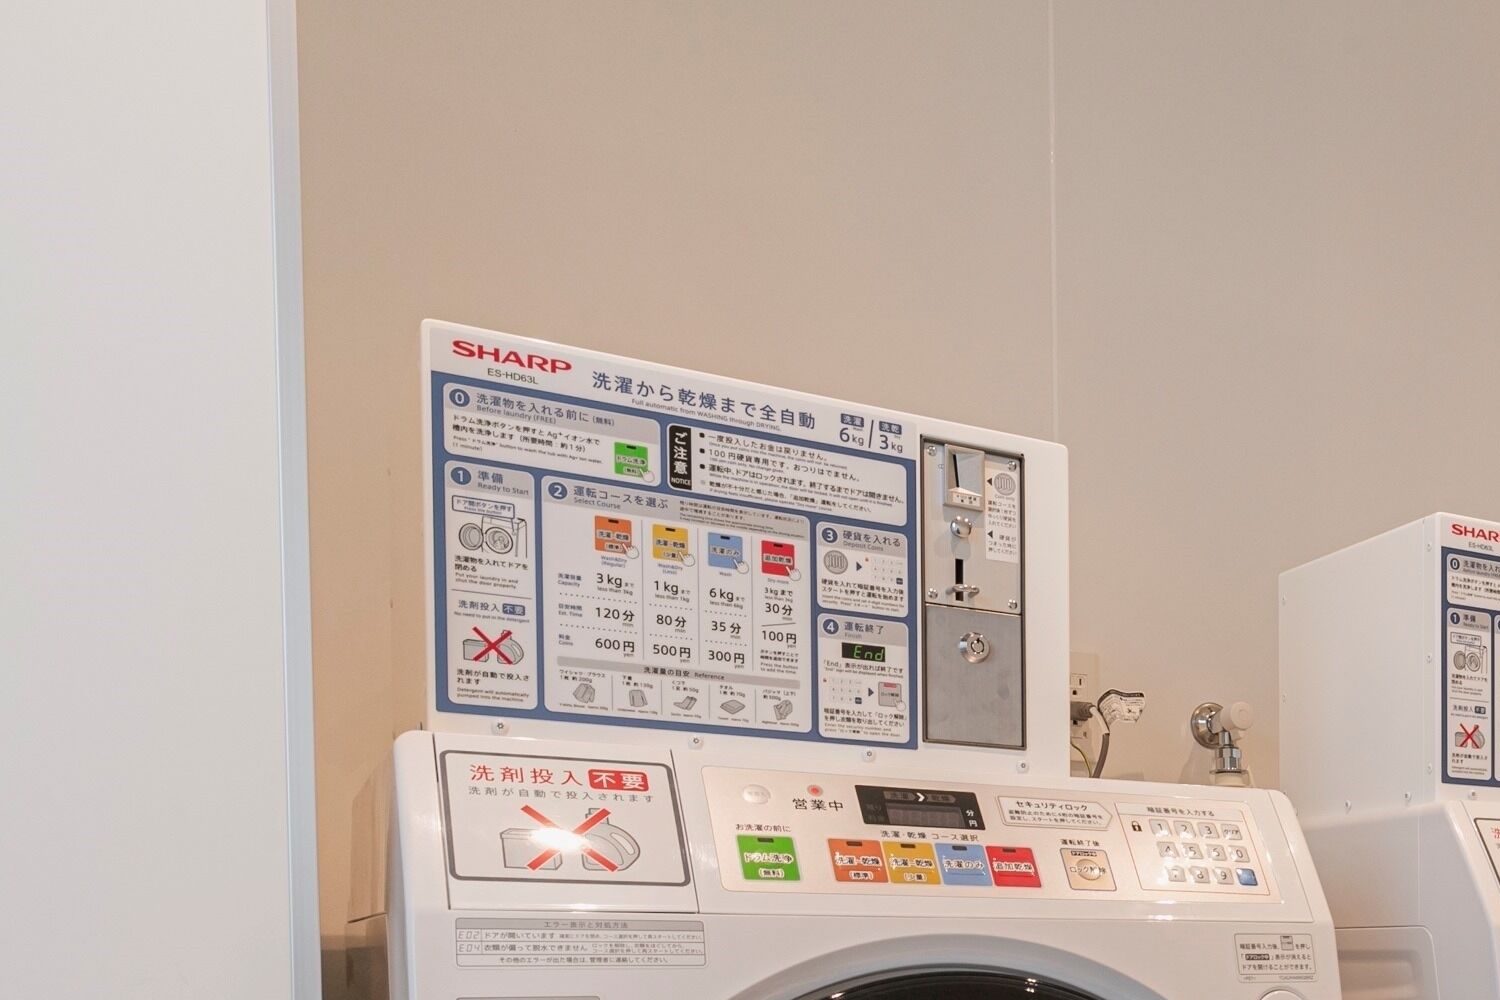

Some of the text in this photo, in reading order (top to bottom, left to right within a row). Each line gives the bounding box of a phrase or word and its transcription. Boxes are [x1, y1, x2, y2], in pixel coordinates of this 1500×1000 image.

[452, 340, 572, 374] SHARP
[487, 367, 538, 385] ES-HD63L
[592, 370, 816, 430] 洗濯から乾燥まで全自動
[476, 392, 589, 423] 洗濯物を入れる前に
[673, 431, 688, 476] ご注意
[477, 470, 504, 485] 準備
[671, 477, 692, 487] NOTICE
[477, 482, 529, 496] Ready to Start
[573, 485, 669, 510] 運転コースを選ぶ
[842, 530, 901, 547] 硬貨を入れる
[458, 599, 500, 613] 洗剤投入
[844, 621, 884, 635] 運転終了
[853, 645, 885, 661] End
[643, 665, 690, 678] 洗濯量の目安
[469, 763, 645, 790] 洗剤投入 不要
[467, 786, 654, 803] 洗剤が自動で投入されます
[792, 798, 844, 812] 営業中
[1016, 800, 1088, 812] セキュリティロック
[1146, 806, 1215, 817] 暗証番号を入力する
[966, 809, 975, 817] 分
[735, 823, 792, 833] お洗濯の前に
[968, 820, 978, 828] 円
[1204, 825, 1213, 835] 3
[931, 833, 979, 842] コース選択
[1060, 838, 1100, 847] 運転終了後
[744, 852, 793, 864] ドラム洗浄
